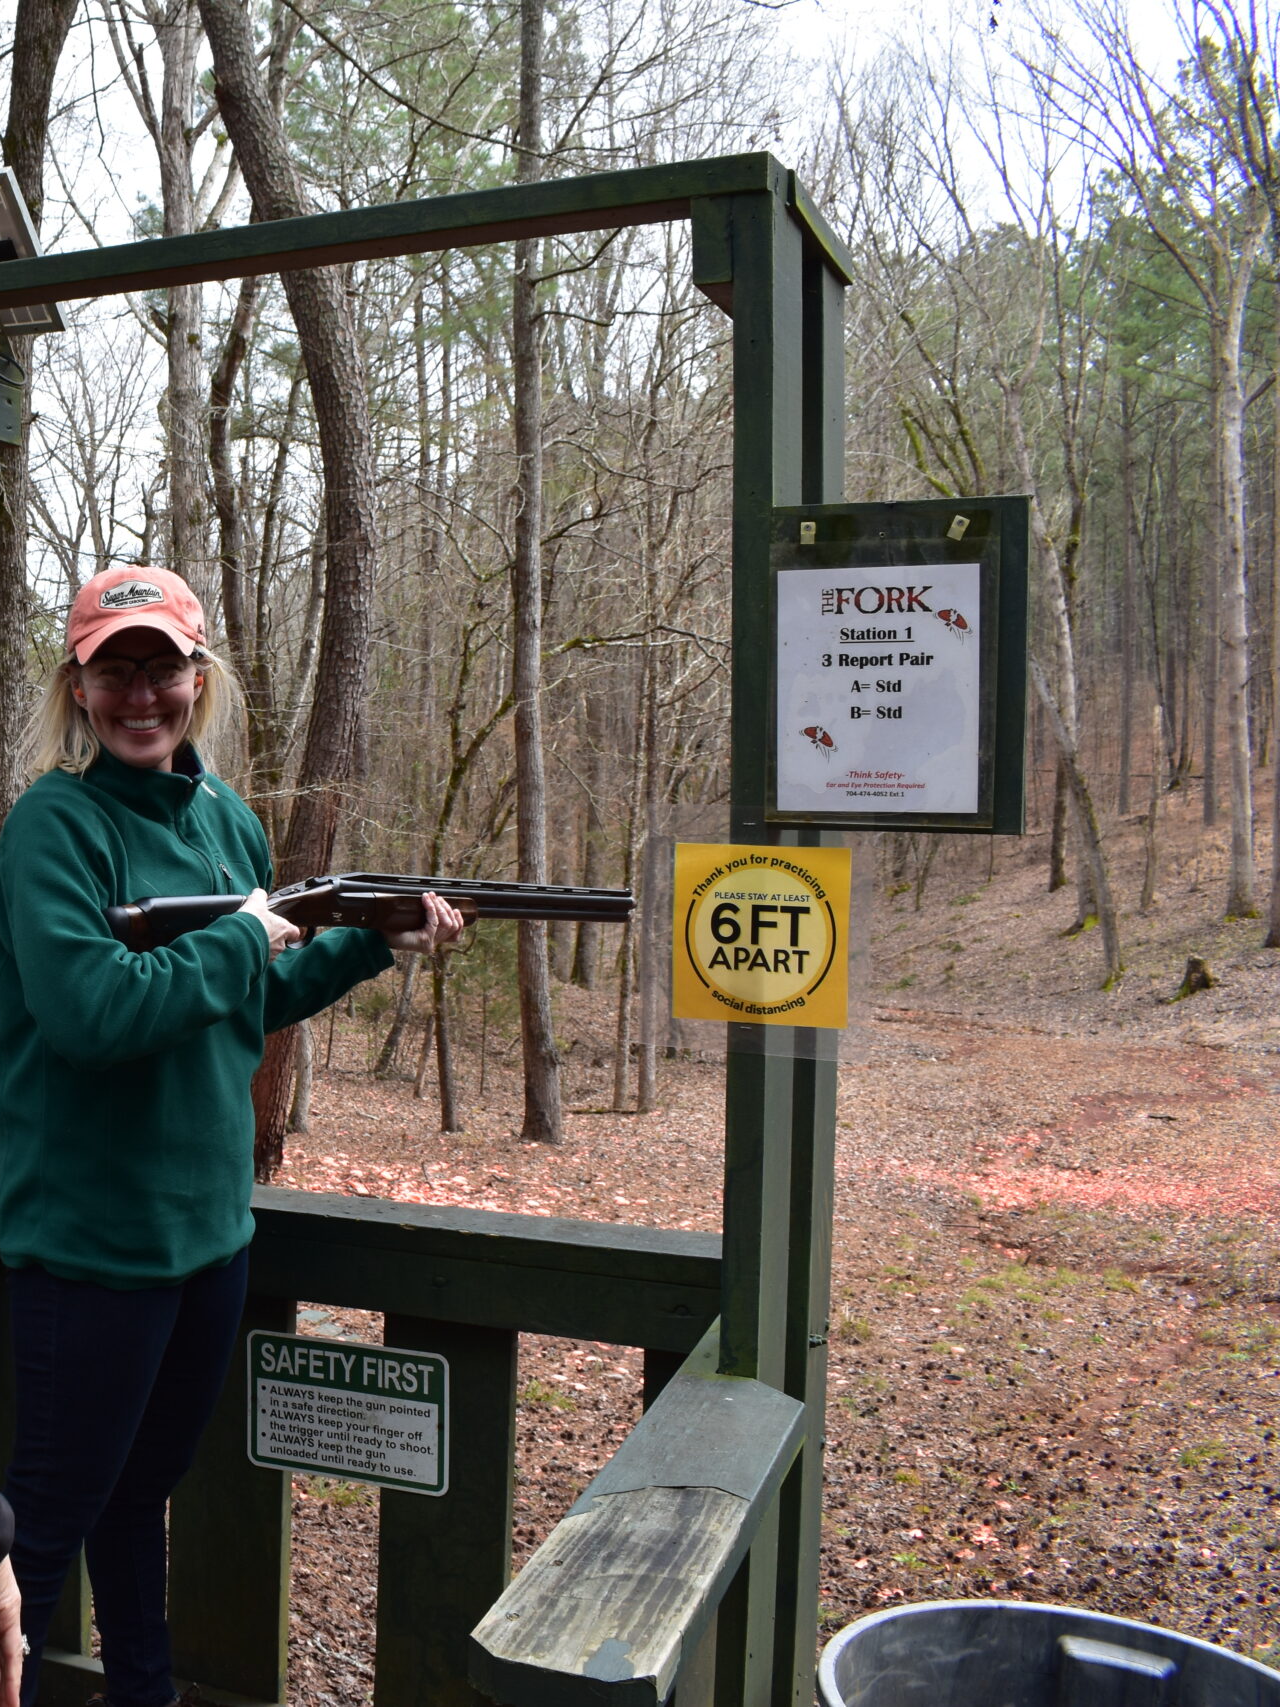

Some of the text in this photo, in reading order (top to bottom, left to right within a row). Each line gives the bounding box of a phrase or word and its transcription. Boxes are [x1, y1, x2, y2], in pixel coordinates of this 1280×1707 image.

[125, 583, 160, 597] Mountain
[822, 586, 933, 616] THE FORK
[840, 627, 912, 641] Station 1
[822, 652, 934, 669] 3 Report Pair
[851, 680, 902, 693] A= Std
[850, 706, 902, 719] B= Std
[692, 854, 826, 899] Thank you for practicing
[714, 892, 746, 900] PLEASE
[711, 903, 810, 946] 6 FT
[708, 946, 810, 974] APART
[712, 990, 806, 1014] social distancing
[260, 1342, 434, 1395] SAFETY FIRST
[270, 1386, 430, 1418] ALWAYS keep the gun pointed
[270, 1397, 279, 1407] in
[292, 1401, 313, 1412] safe
[316, 1405, 366, 1420] direction.
[270, 1409, 422, 1441] ALWAYS keep your finger off
[270, 1421, 434, 1456] the trigger until ready to shoot.
[270, 1432, 386, 1459] ALWAYS keep the gun
[270, 1445, 416, 1476] unloaded until ready to use.
